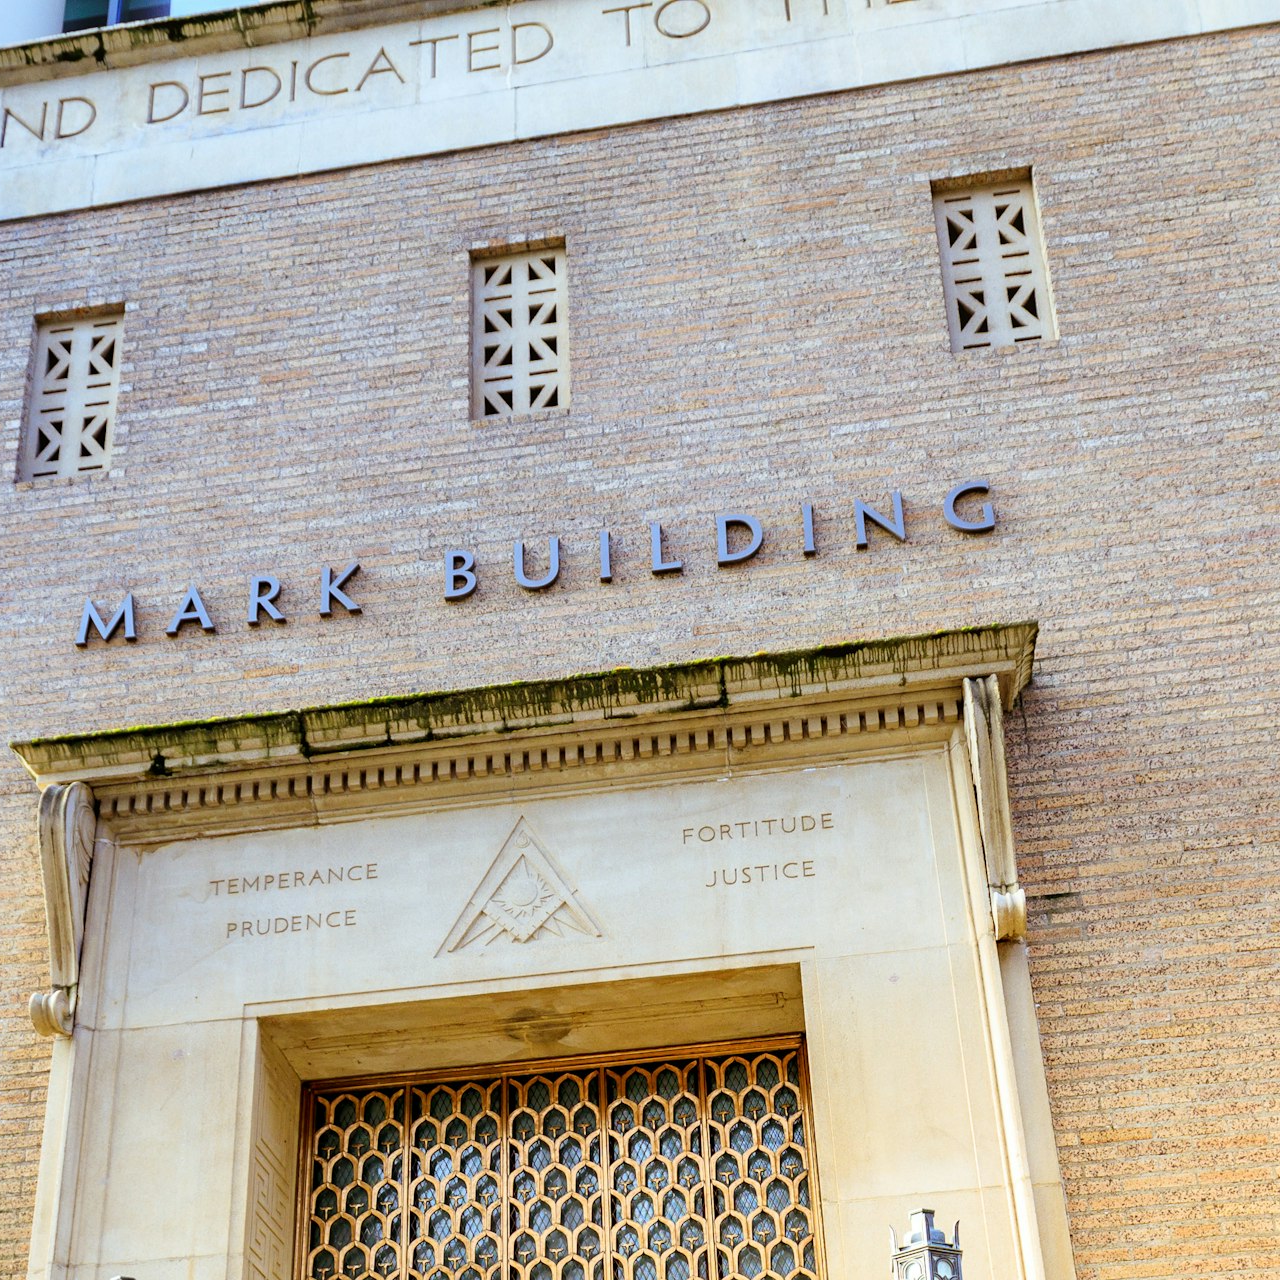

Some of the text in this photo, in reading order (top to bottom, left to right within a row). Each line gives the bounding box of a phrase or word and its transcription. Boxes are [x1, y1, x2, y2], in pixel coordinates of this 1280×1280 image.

[148, 22, 553, 124] DEDICATED
[602, 0, 711, 47] TO
[74, 479, 995, 647] MARK BUILDING
[682, 812, 835, 845] FORTITUDE
[209, 862, 378, 896] TEMPERANCE
[705, 860, 816, 888] JUSTICE
[226, 909, 357, 939] PRUDENCE
